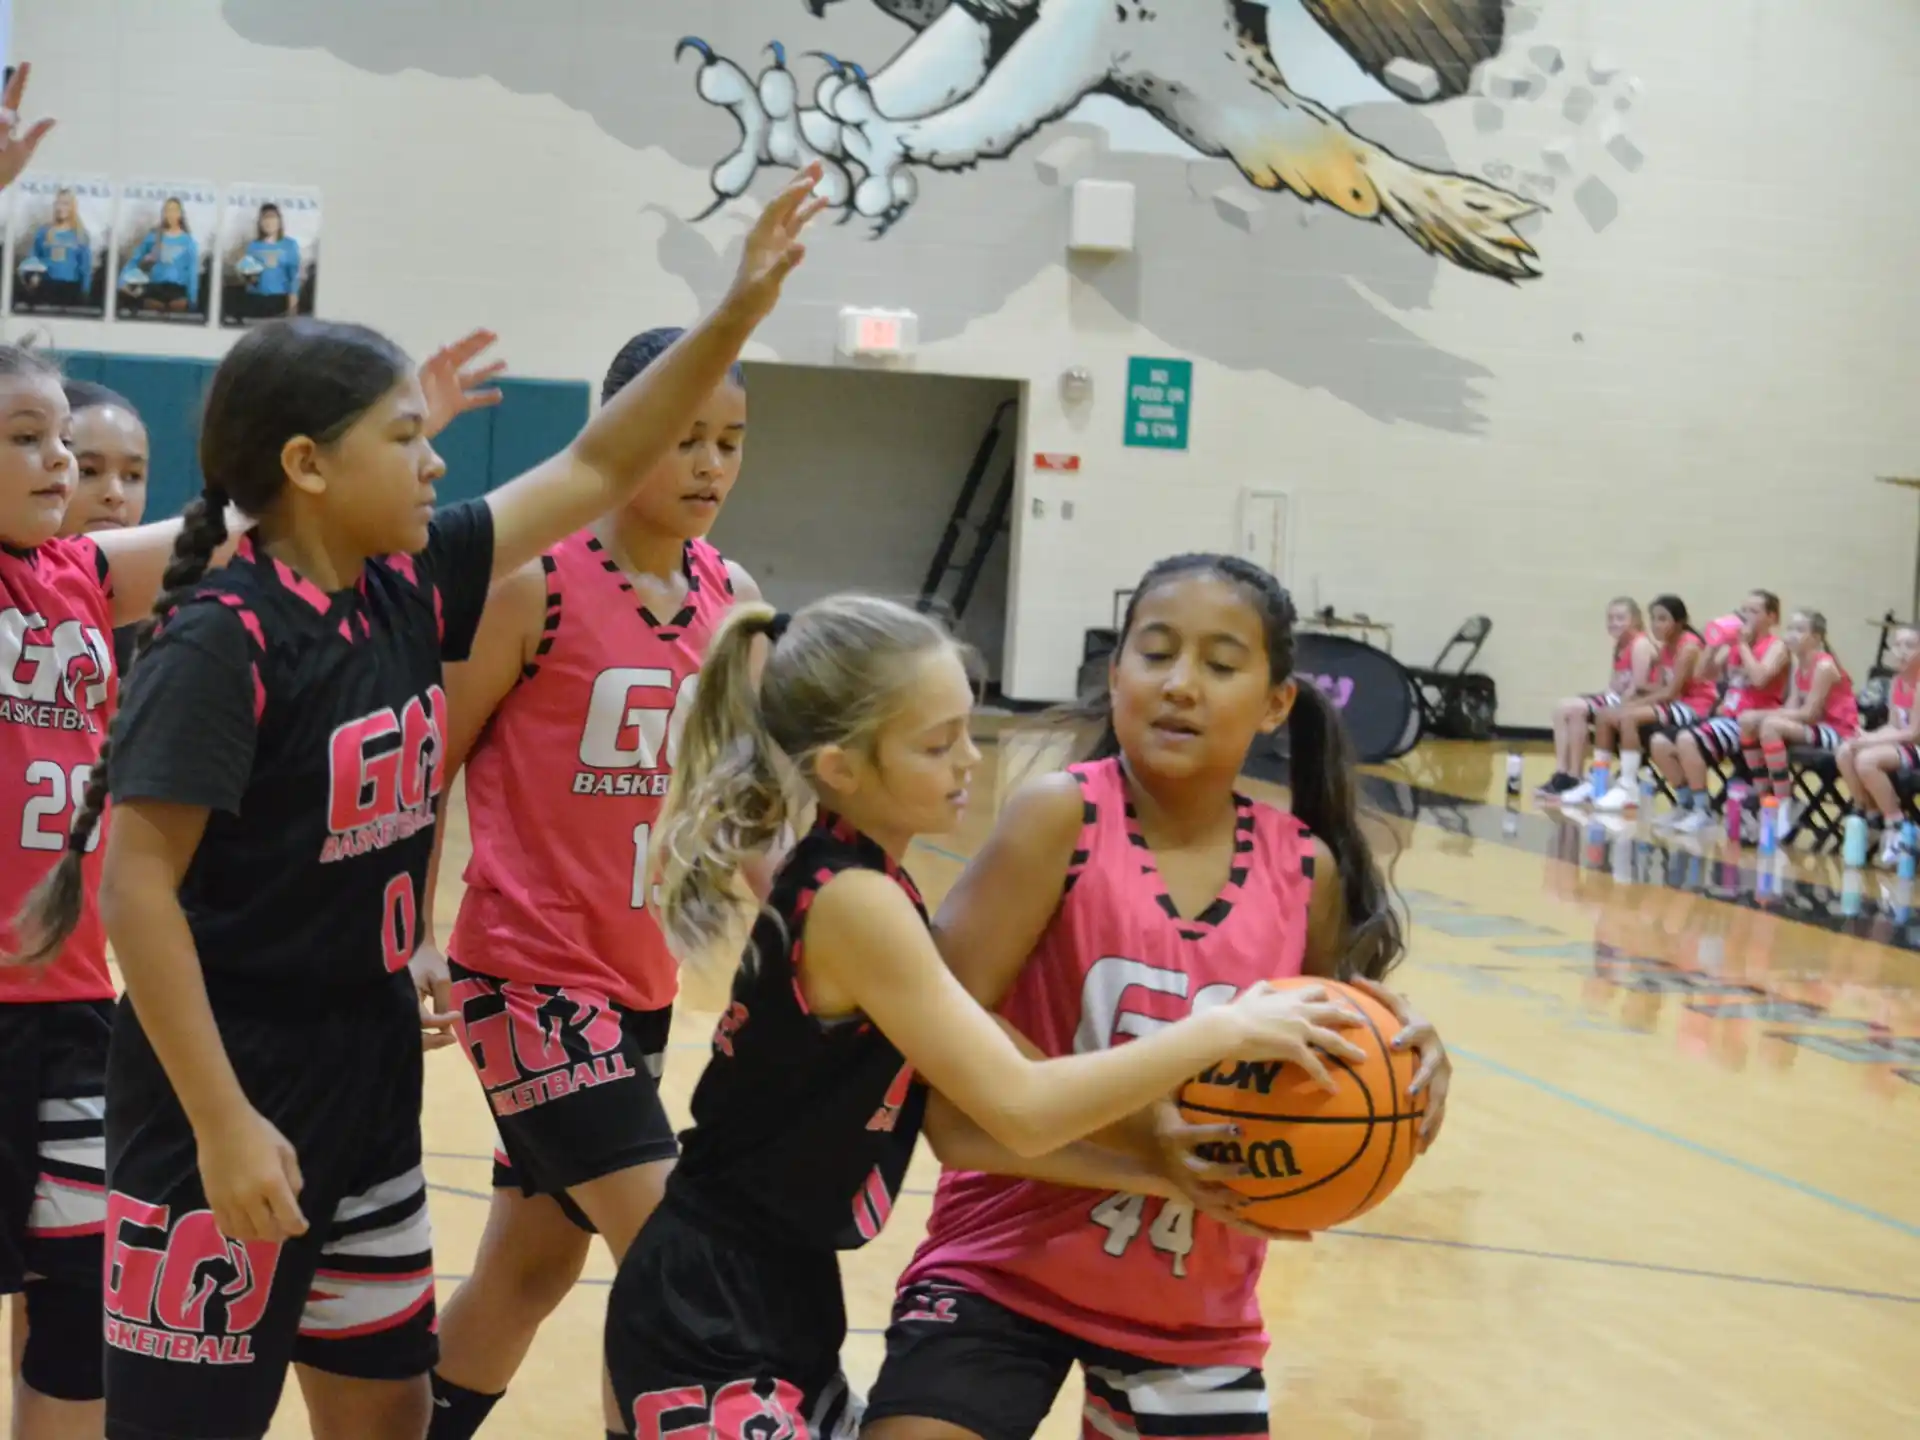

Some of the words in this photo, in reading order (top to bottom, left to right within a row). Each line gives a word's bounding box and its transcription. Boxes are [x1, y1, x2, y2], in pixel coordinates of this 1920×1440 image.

[381, 871, 416, 973] 0
[1090, 1190, 1196, 1279] 44
[105, 1318, 255, 1365] SKETBALL
